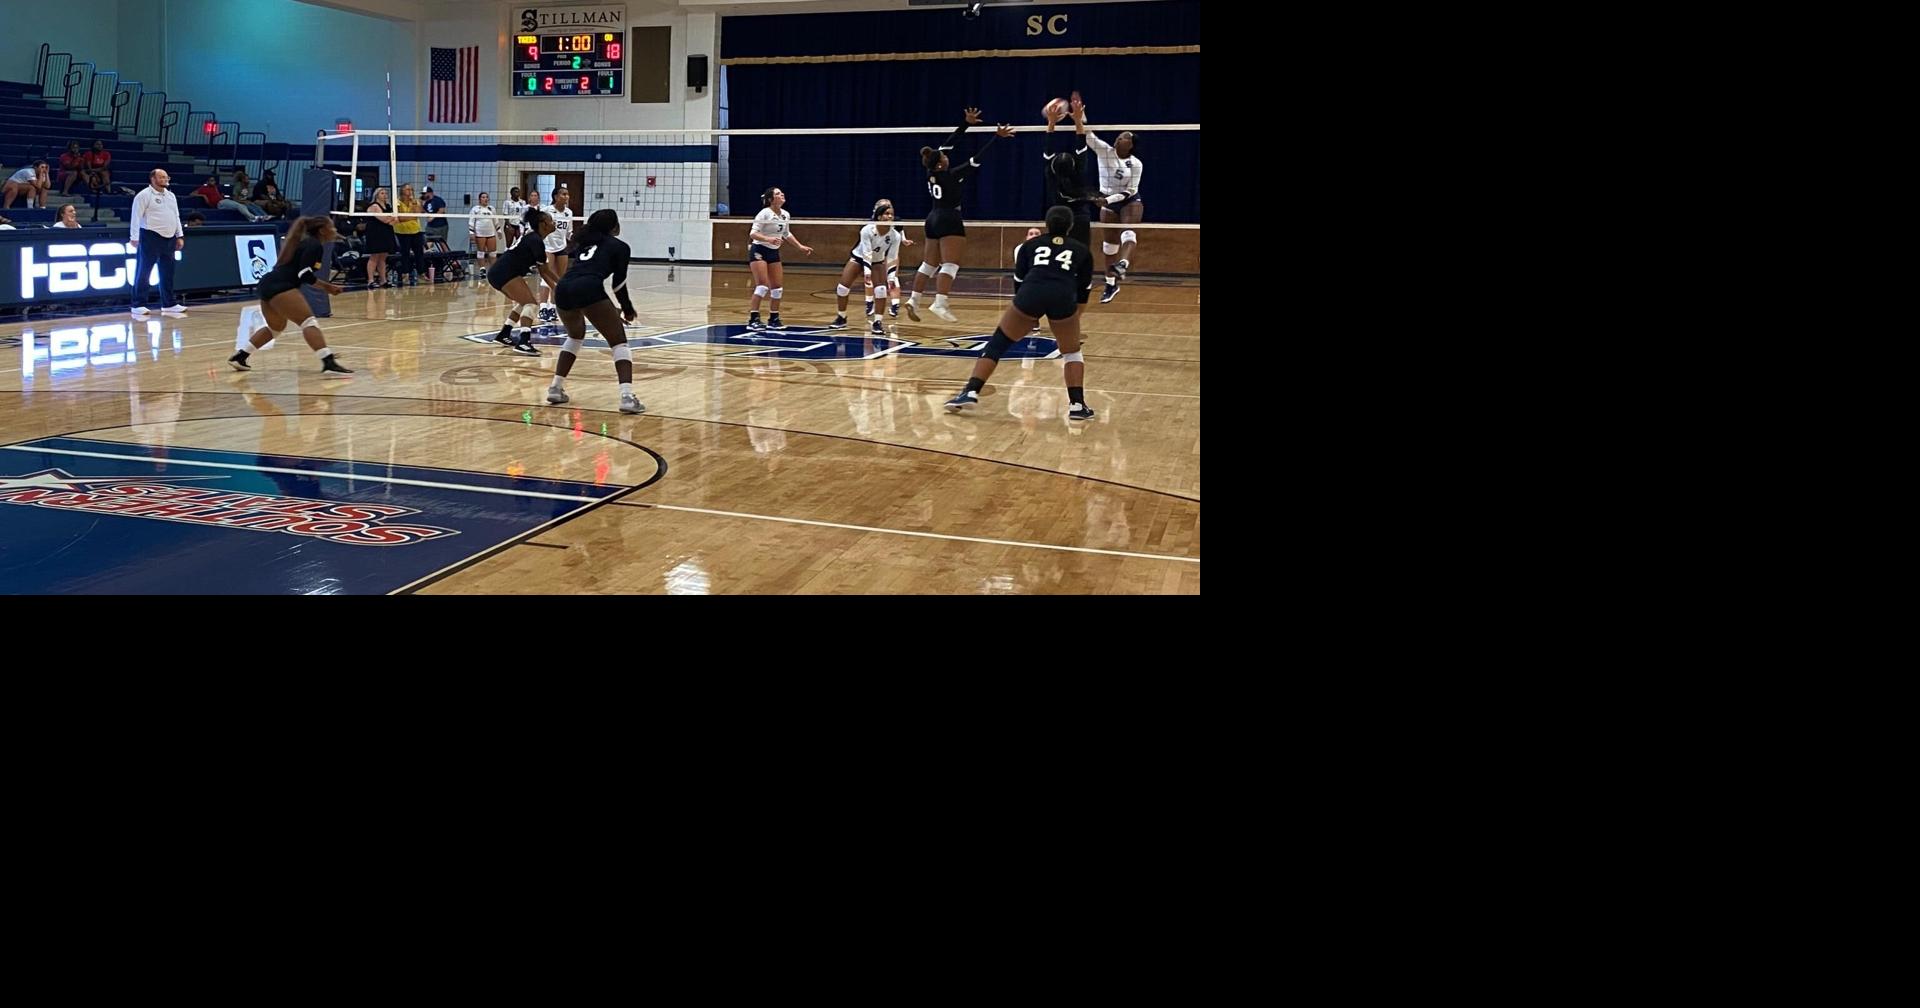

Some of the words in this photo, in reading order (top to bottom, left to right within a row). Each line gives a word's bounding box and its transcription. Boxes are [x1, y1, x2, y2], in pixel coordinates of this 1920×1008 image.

[521, 9, 621, 32] STILLMAN
[1027, 14, 1068, 36] SC
[558, 35, 591, 51] 1:00
[528, 46, 538, 61] 9
[606, 43, 620, 59] 18
[572, 56, 581, 69] 2
[528, 77, 537, 91] 0
[545, 77, 553, 90] 2
[580, 76, 589, 90] 2
[609, 76, 614, 89] 1
[1115, 169, 1124, 180] 5
[557, 220, 568, 230] 20
[579, 244, 598, 261] 3
[1033, 246, 1073, 271] 24
[84, 484, 407, 522] STATES
